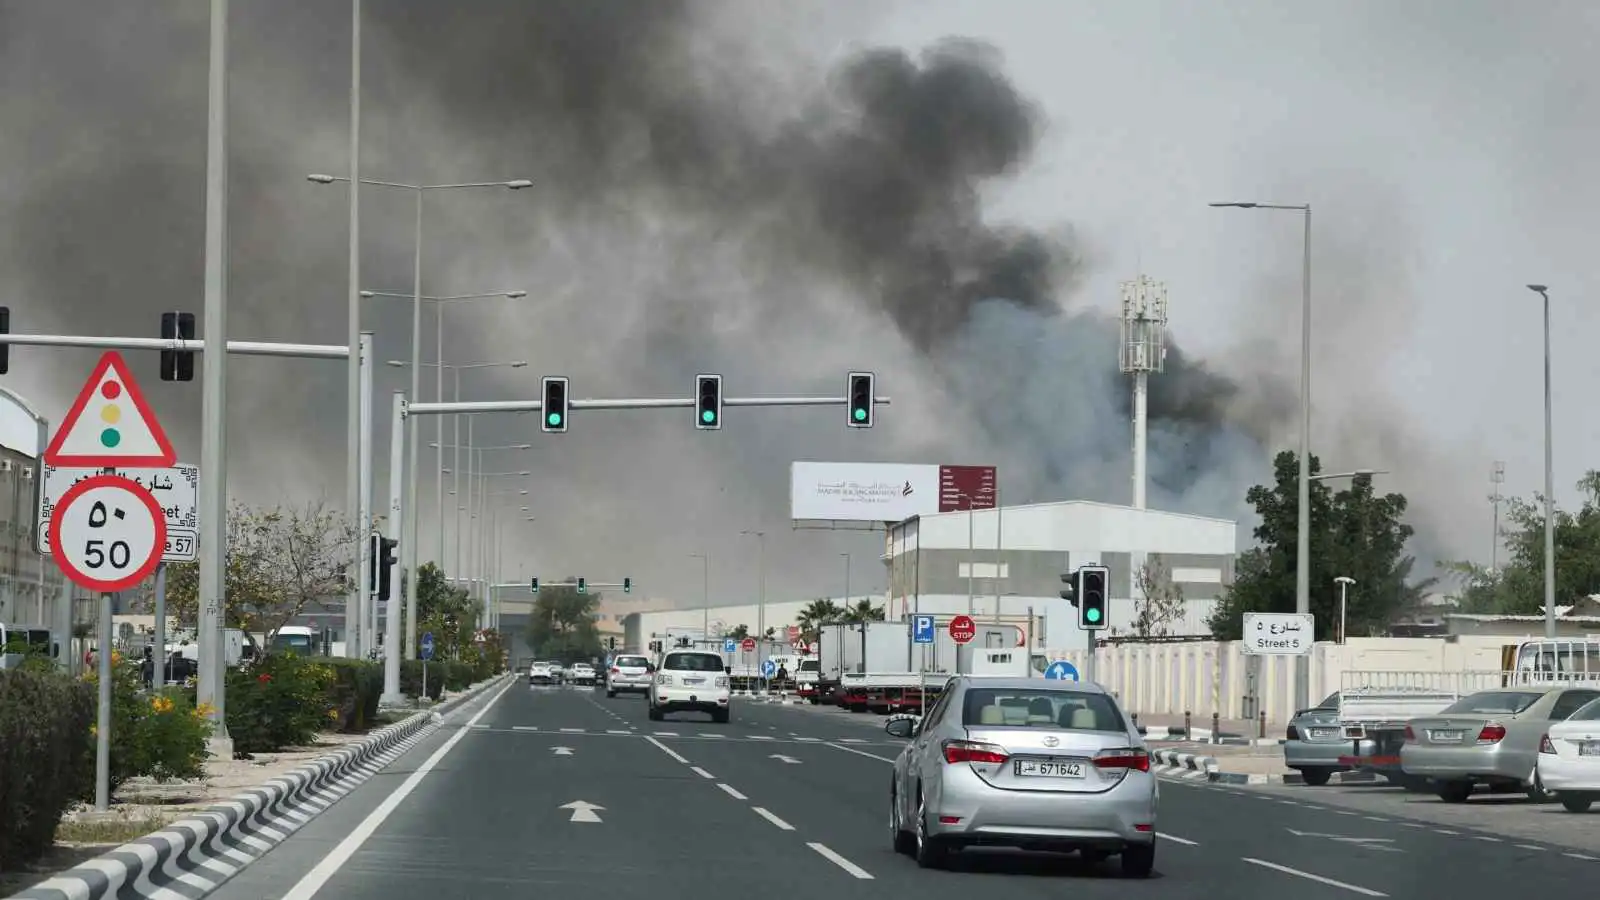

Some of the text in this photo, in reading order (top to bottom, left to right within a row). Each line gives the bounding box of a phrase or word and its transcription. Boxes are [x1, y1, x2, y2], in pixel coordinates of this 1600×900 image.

[88, 500, 126, 528] ٥٠
[175, 539, 192, 553] 57
[84, 540, 131, 569] 50
[917, 617, 931, 634] P
[1257, 621, 1302, 635] شارع ٥
[953, 631, 974, 639] STOP
[1257, 638, 1300, 648] Street 5
[1040, 763, 1081, 776] 671642
